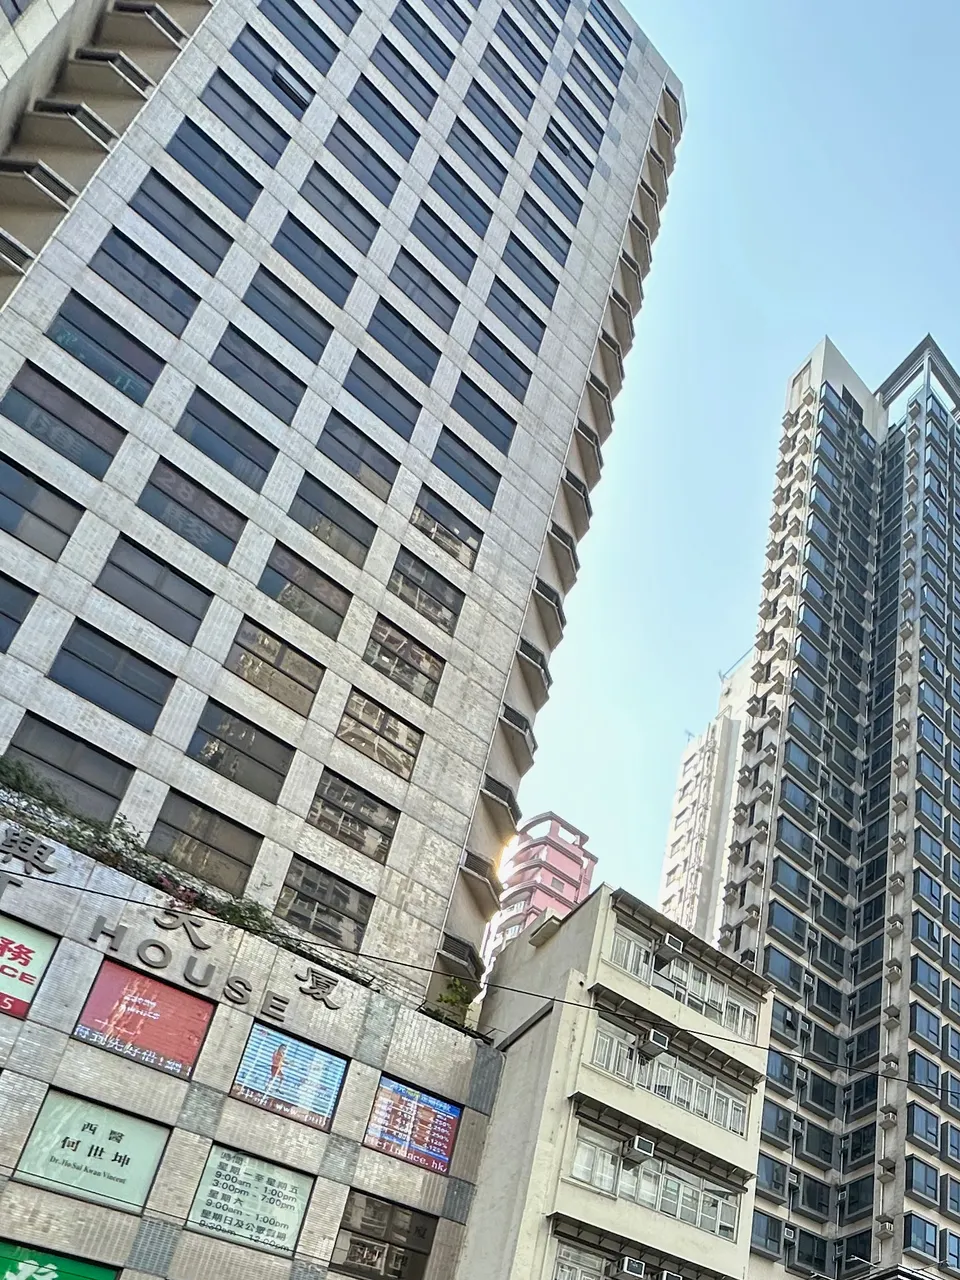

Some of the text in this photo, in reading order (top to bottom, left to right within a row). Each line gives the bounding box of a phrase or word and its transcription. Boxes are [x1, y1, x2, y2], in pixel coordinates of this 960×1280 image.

[89, 915, 290, 1022] HOUSE
[81, 1122, 125, 1144] 西醫
[61, 1136, 131, 1168] 何世坤
[212, 1179, 249, 1197] 3:00pm
[260, 1194, 295, 1212] 7:00pm
[215, 1170, 251, 1188] 9:00am
[263, 1186, 297, 1203] 1:00pm
[205, 1198, 243, 1216] 9:00am
[255, 1213, 290, 1230] 1:00pm
